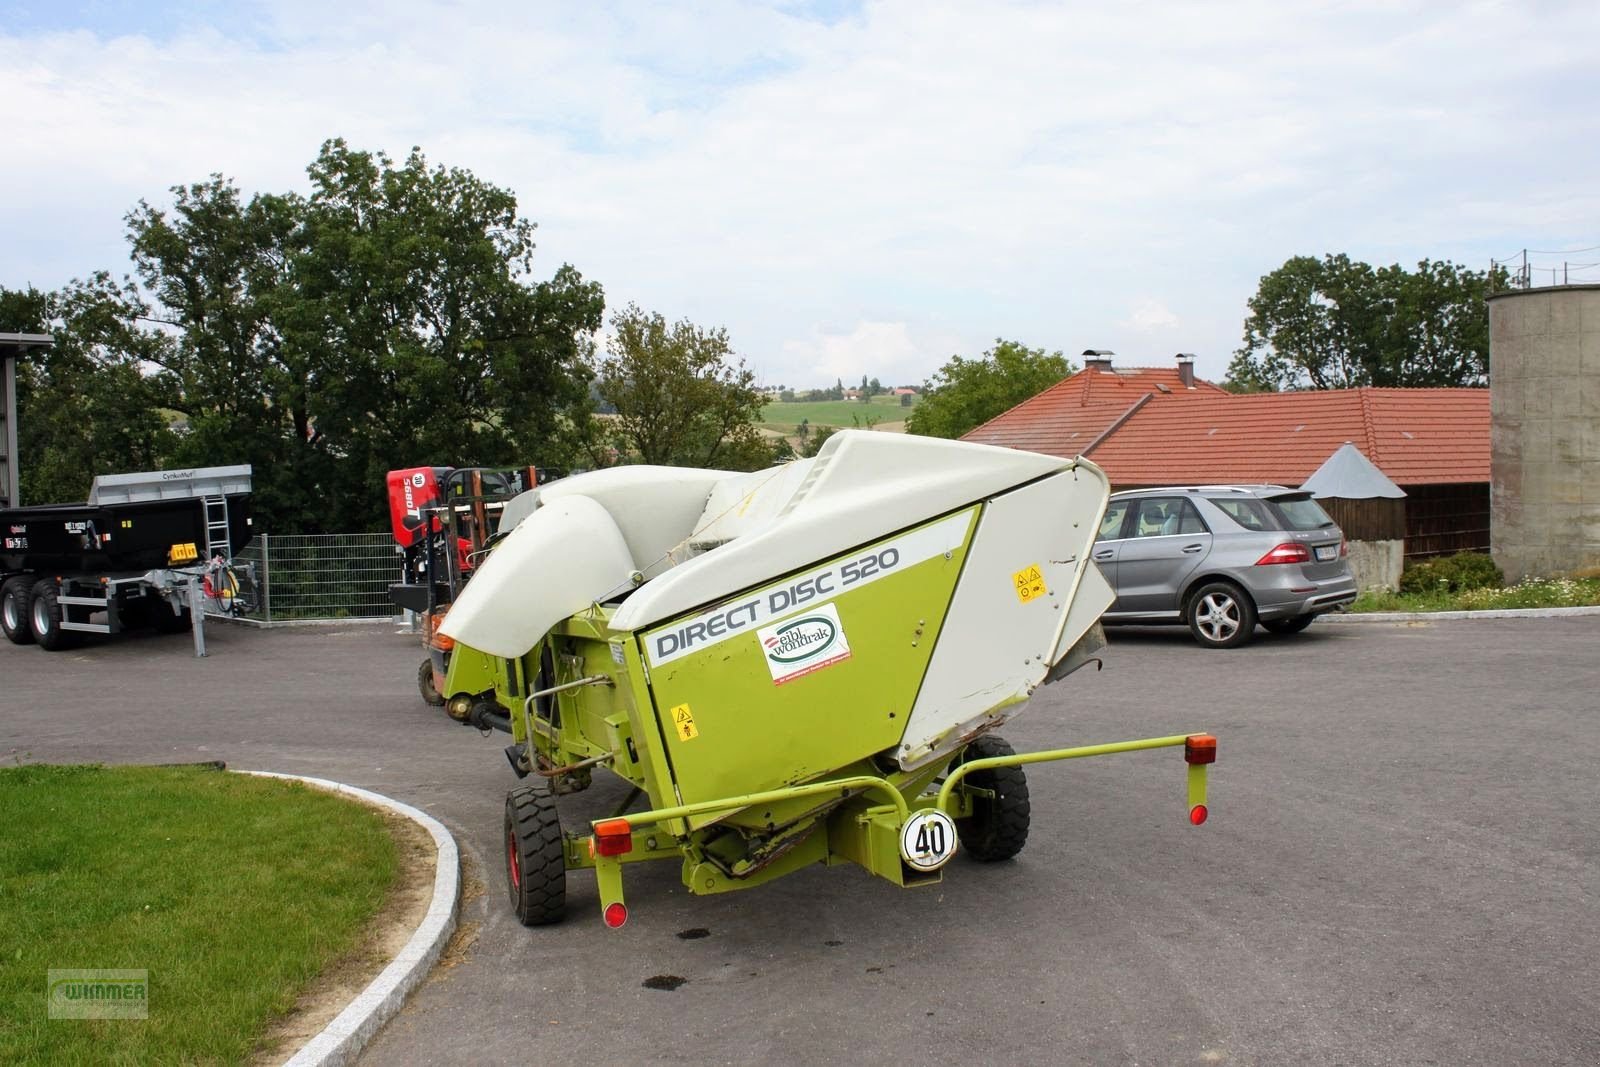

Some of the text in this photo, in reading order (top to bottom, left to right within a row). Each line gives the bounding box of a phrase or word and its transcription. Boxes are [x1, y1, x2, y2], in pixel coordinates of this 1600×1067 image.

[414, 476, 423, 485] 30
[657, 547, 899, 658] DIRECT DISC 520
[773, 628, 829, 655] wondrak
[780, 627, 803, 645] eibl
[915, 821, 945, 856] 40
